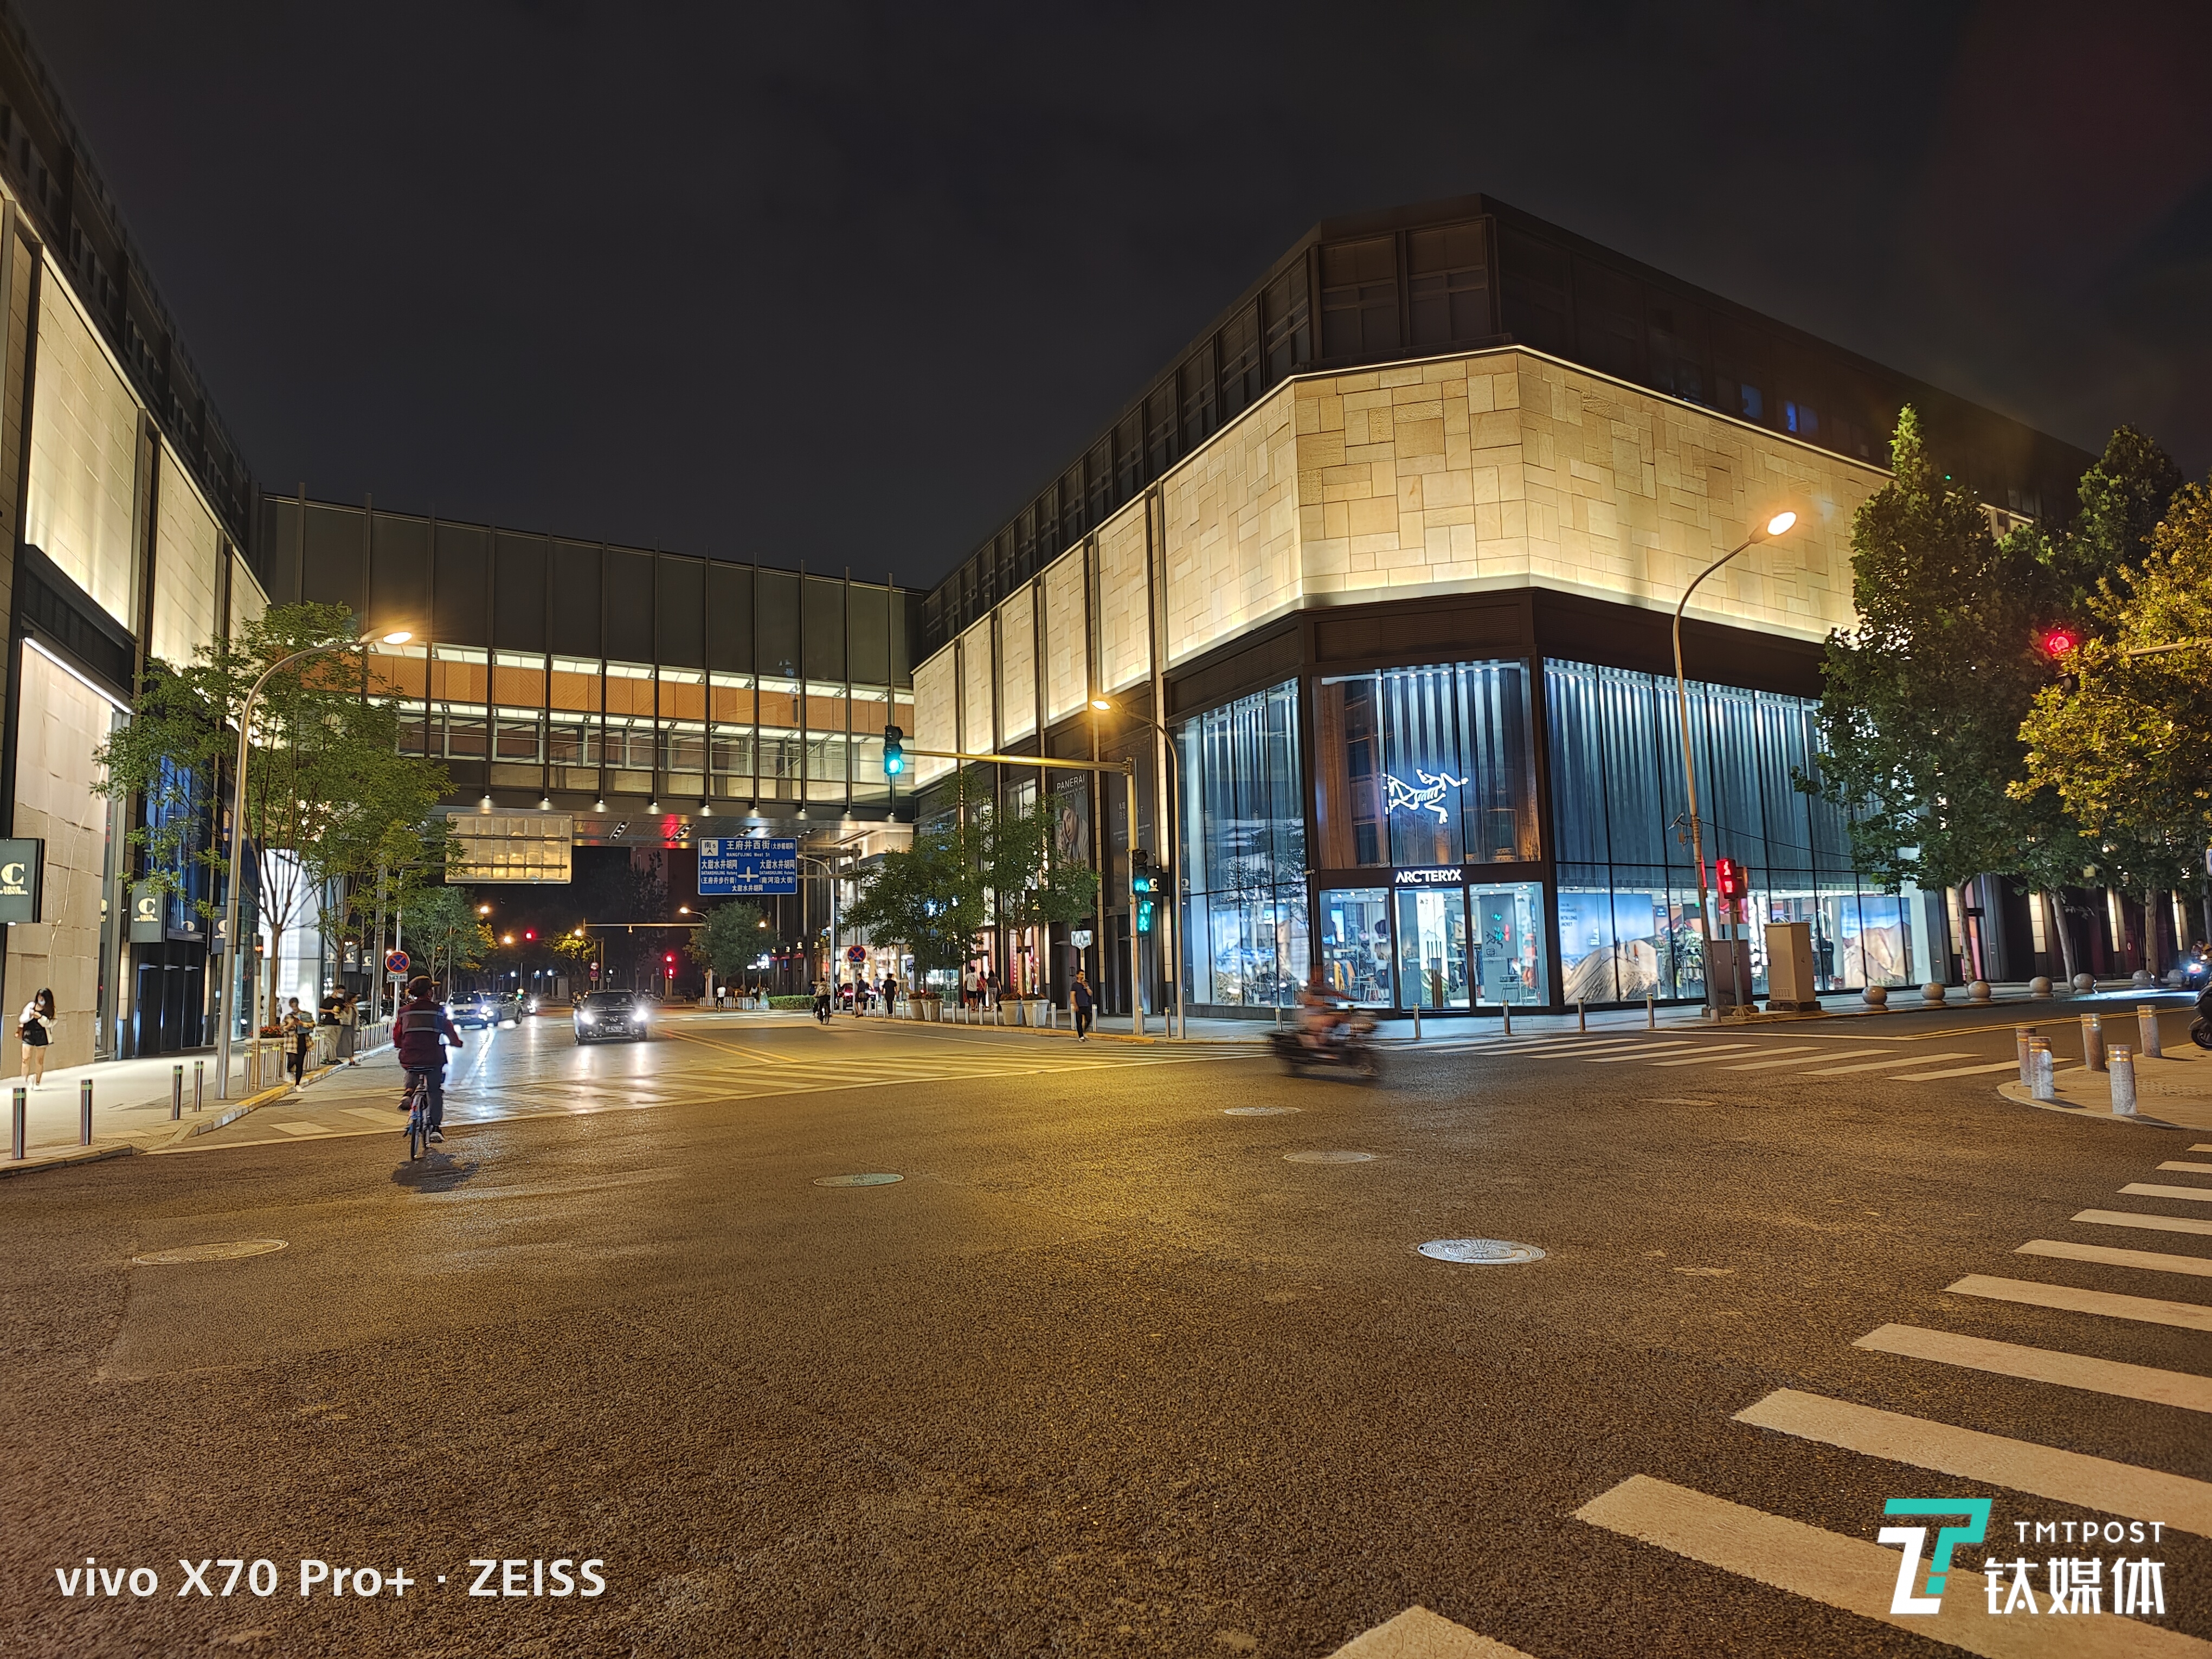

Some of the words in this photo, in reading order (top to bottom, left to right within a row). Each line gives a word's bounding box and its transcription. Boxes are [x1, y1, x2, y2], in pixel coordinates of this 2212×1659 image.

[1057, 774, 1085, 792] PANERAI
[726, 840, 770, 850] 王府井西街
[701, 859, 738, 870] 大甜水井胡同
[760, 859, 795, 870] 大甜水井胡同
[1, 863, 25, 885] C
[138, 897, 156, 915] C
